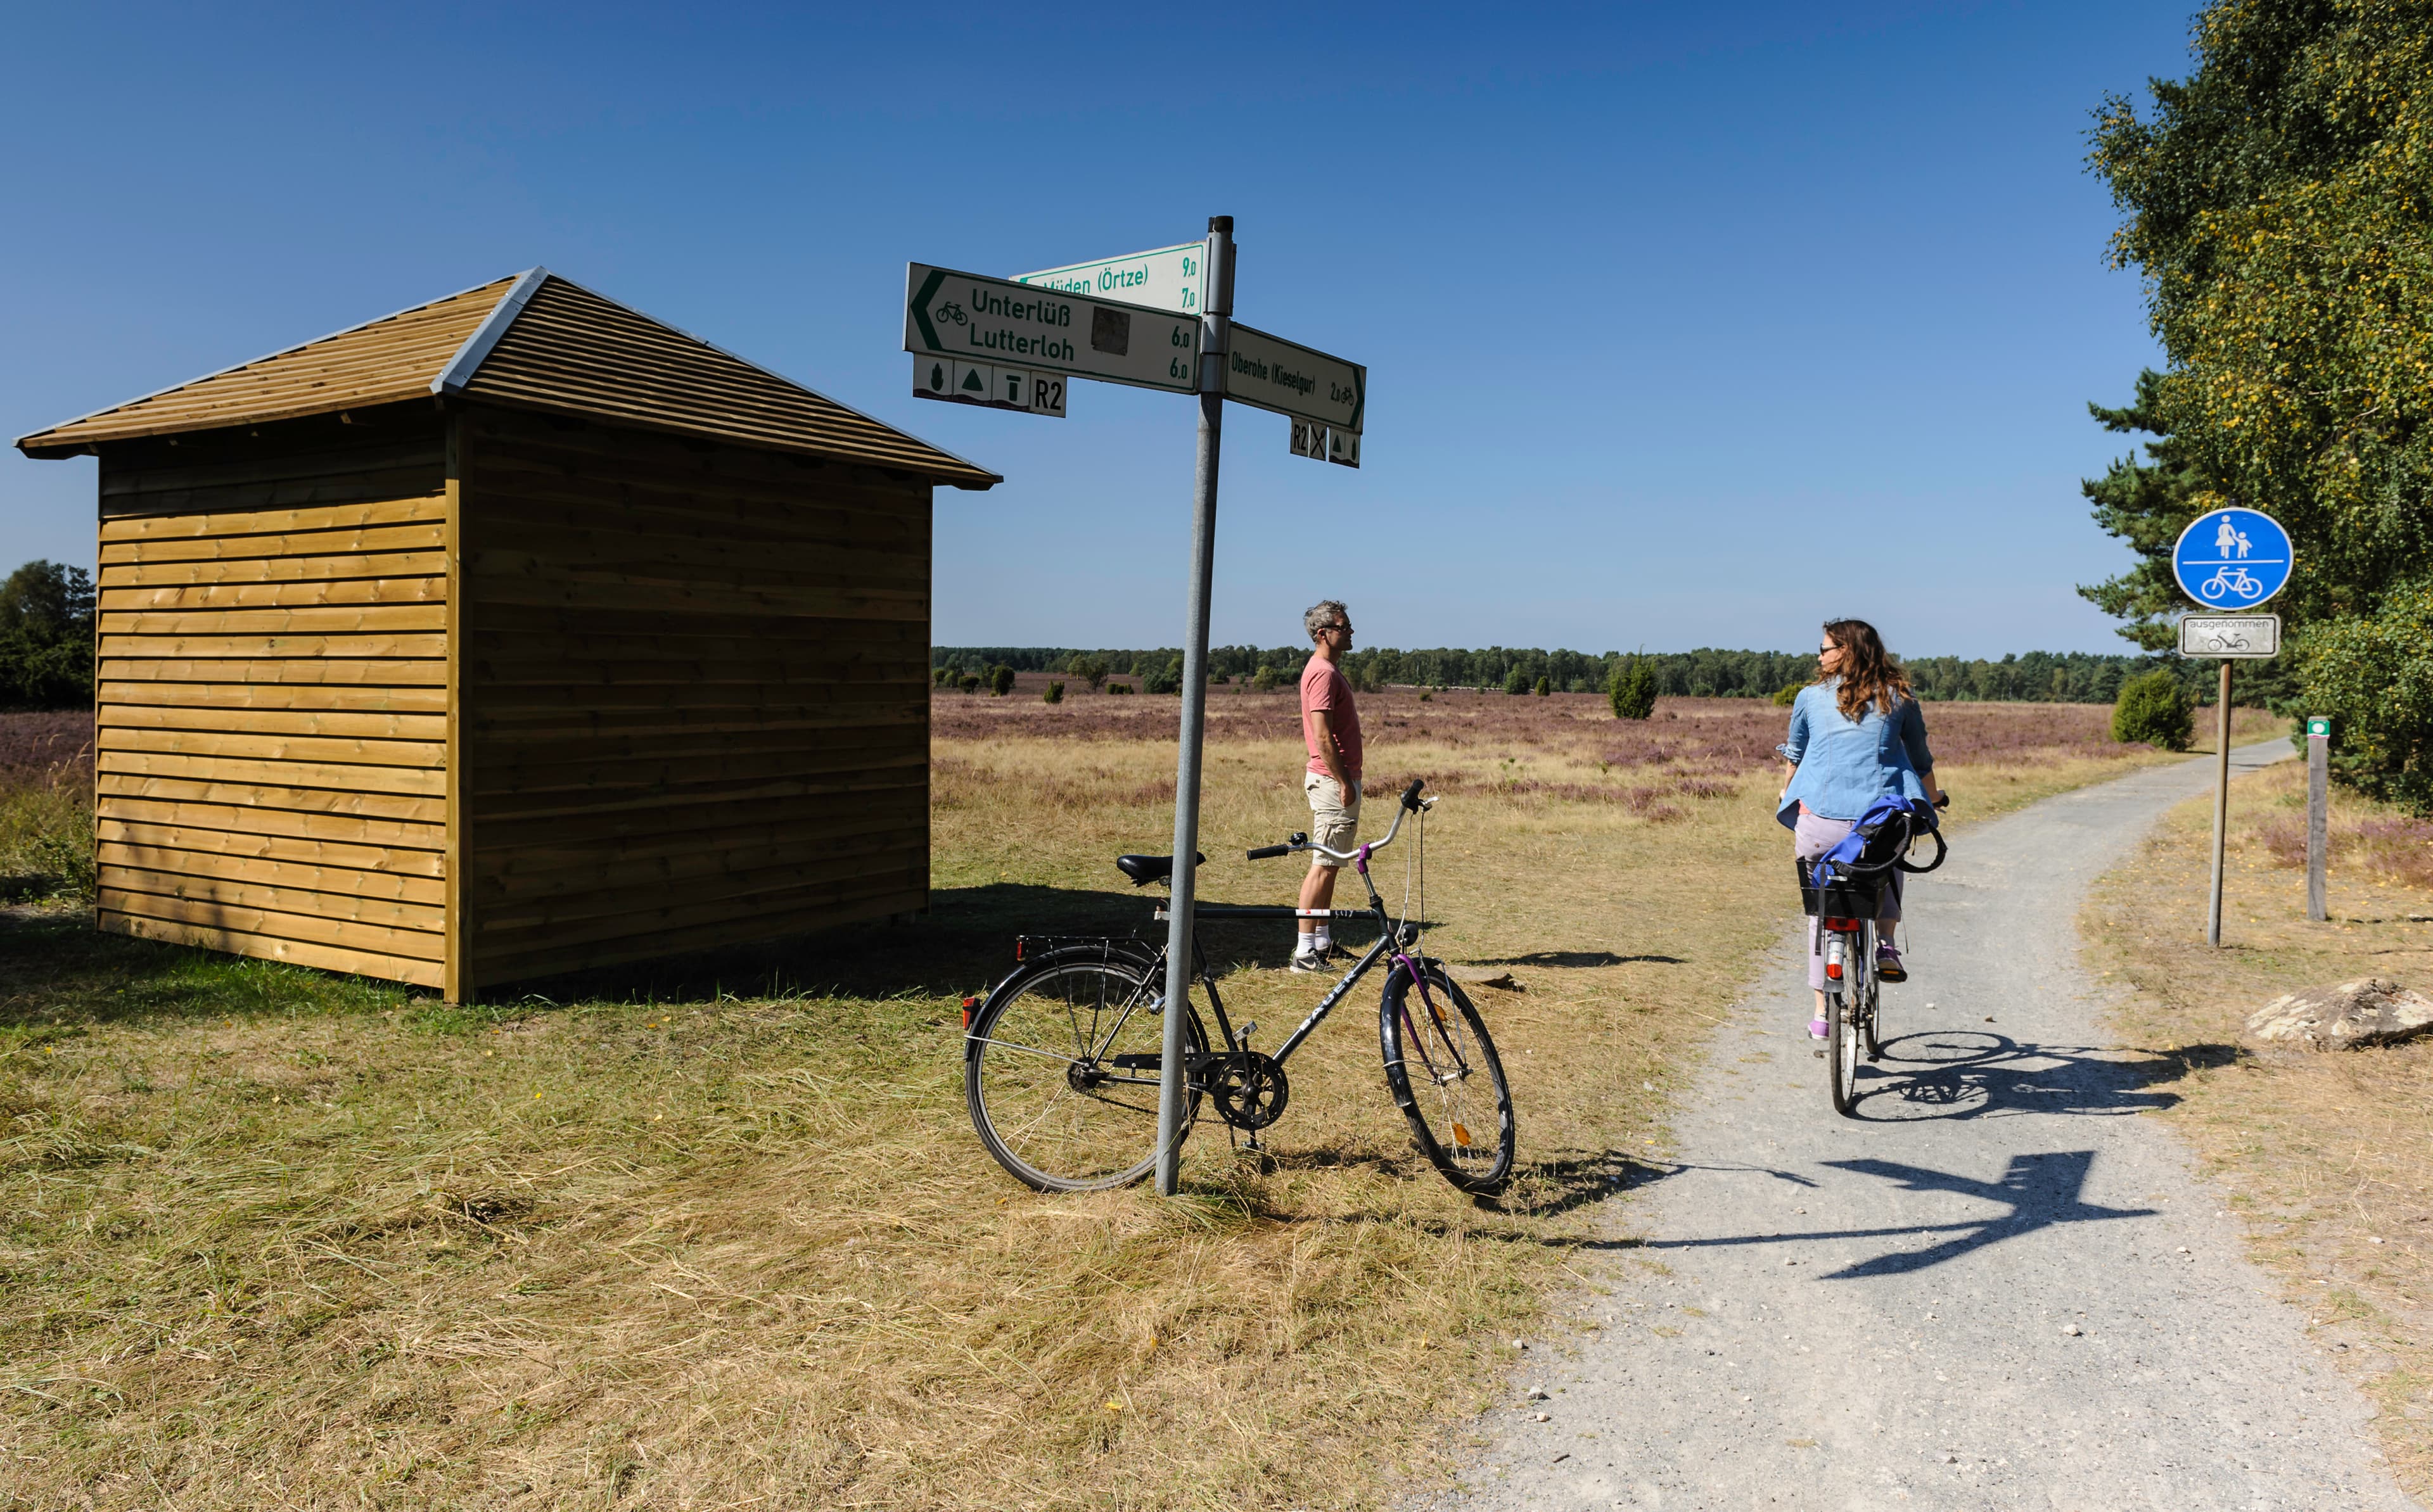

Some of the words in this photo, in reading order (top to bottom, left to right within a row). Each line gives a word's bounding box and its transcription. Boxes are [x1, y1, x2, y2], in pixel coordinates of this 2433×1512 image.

[1098, 264, 1148, 293] (Örtze)
[1182, 257, 1196, 277] 9,0
[1182, 288, 1195, 308] 7,0
[972, 288, 1071, 327] Unterlüß
[1172, 326, 1190, 348] 6,0
[970, 322, 1074, 361] Lutterloh
[1170, 357, 1188, 379] 6,0
[1231, 351, 1268, 381] Oberohe
[1272, 362, 1315, 396] (Kieselgur)
[1035, 378, 1062, 410] R2
[1294, 424, 1307, 450] R2
[2190, 620, 2269, 630] ausgenommen
[1299, 970, 1357, 1031] BAUER
